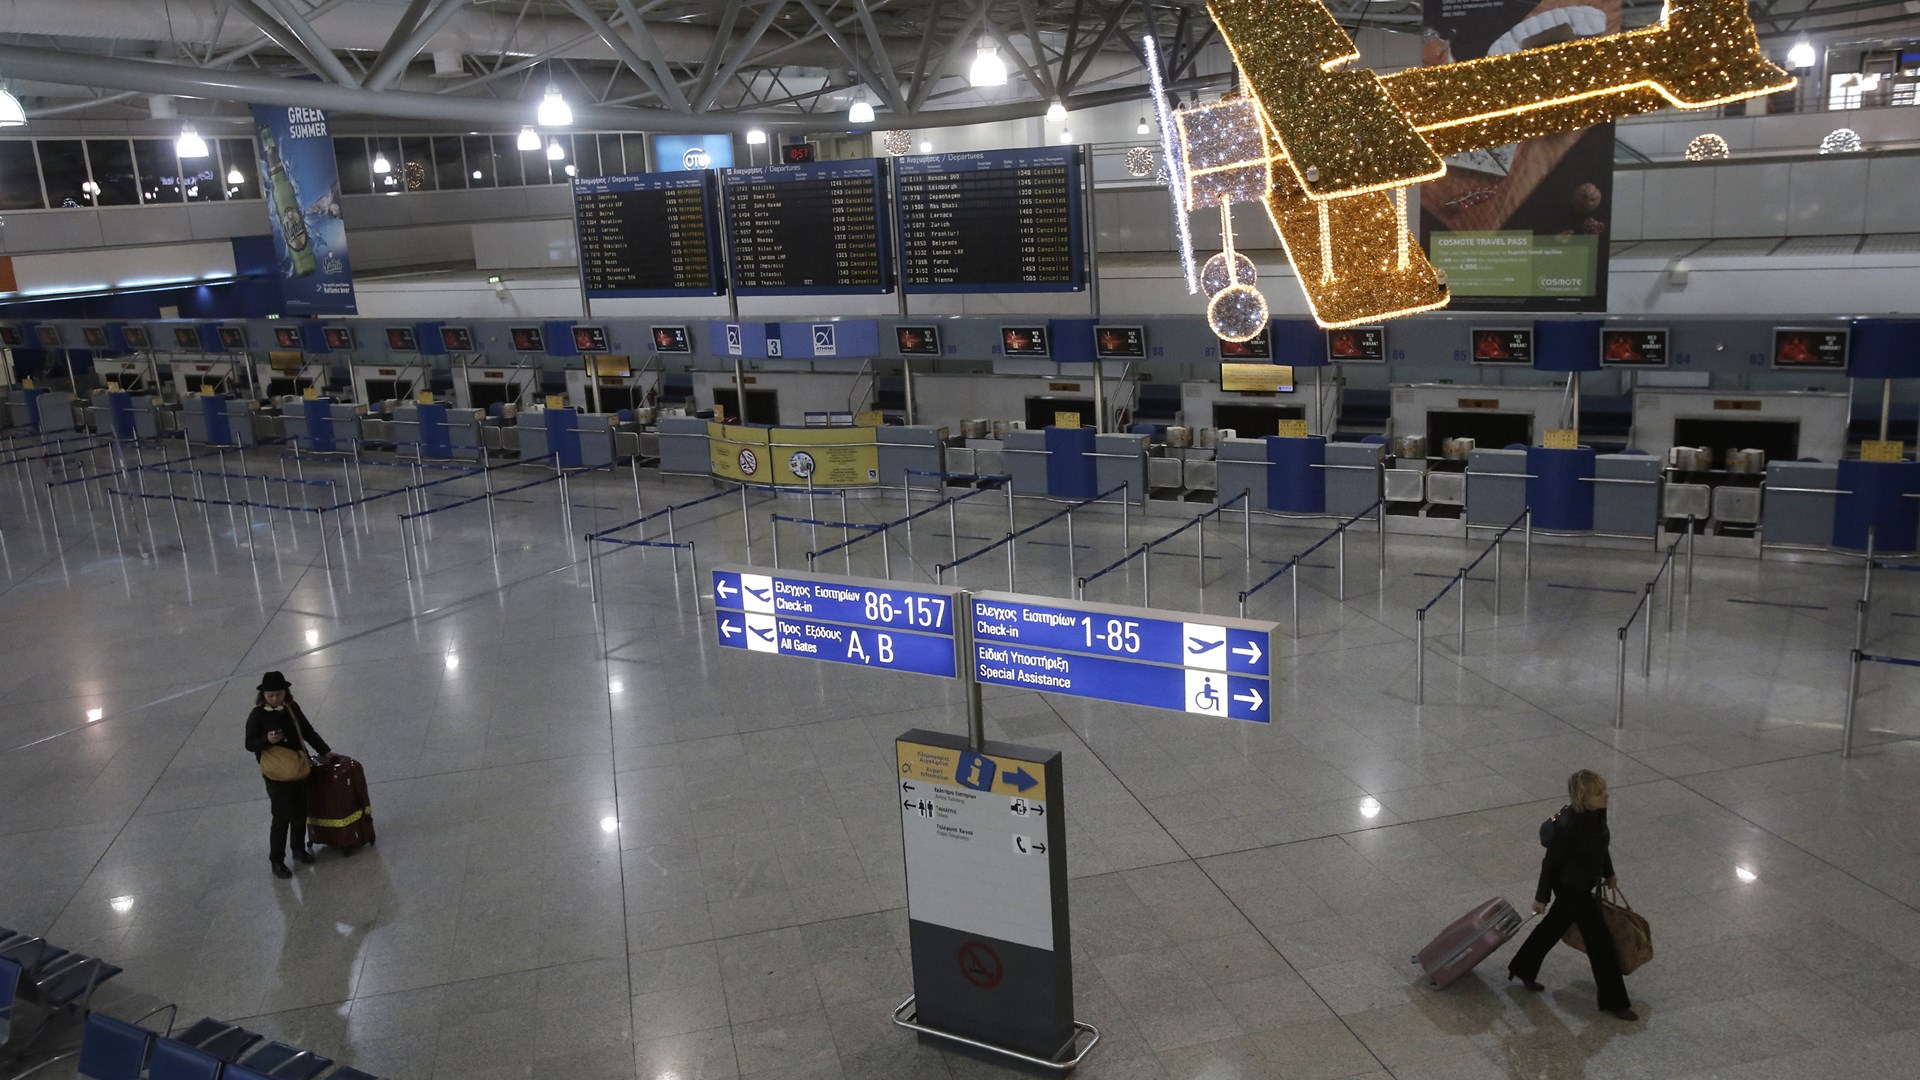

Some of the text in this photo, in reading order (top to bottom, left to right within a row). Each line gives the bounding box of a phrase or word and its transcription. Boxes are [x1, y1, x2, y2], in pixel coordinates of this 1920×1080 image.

[288, 106, 325, 124] GREEK
[289, 123, 327, 138] SUMMER
[948, 153, 984, 162] Departures
[844, 178, 872, 186] Cancelled
[1438, 238, 1528, 246] COSMOTE TRAVEL PASS
[1541, 278, 1582, 286] COSMOTE
[770, 340, 778, 355] 3
[1204, 347, 1215, 357] 87
[1393, 350, 1405, 360] 86
[1454, 350, 1466, 361] 85
[1676, 353, 1690, 365] 84
[776, 596, 812, 613] Check-in
[815, 586, 860, 602] Εισιτηρίων
[864, 591, 946, 628] 86-157
[779, 621, 842, 642] Προς Εξόδους
[977, 621, 1019, 638] Check-in
[1022, 608, 1076, 628] Εισιτηρίων
[1080, 616, 1140, 654] 1-85
[781, 639, 818, 655] All Gates
[847, 630, 894, 664] A, B
[979, 646, 1070, 674] Ειδική Υποστήριξη
[980, 664, 1071, 689] Special Assistance
[920, 772, 949, 780] Information
[926, 767, 944, 775] Airport
